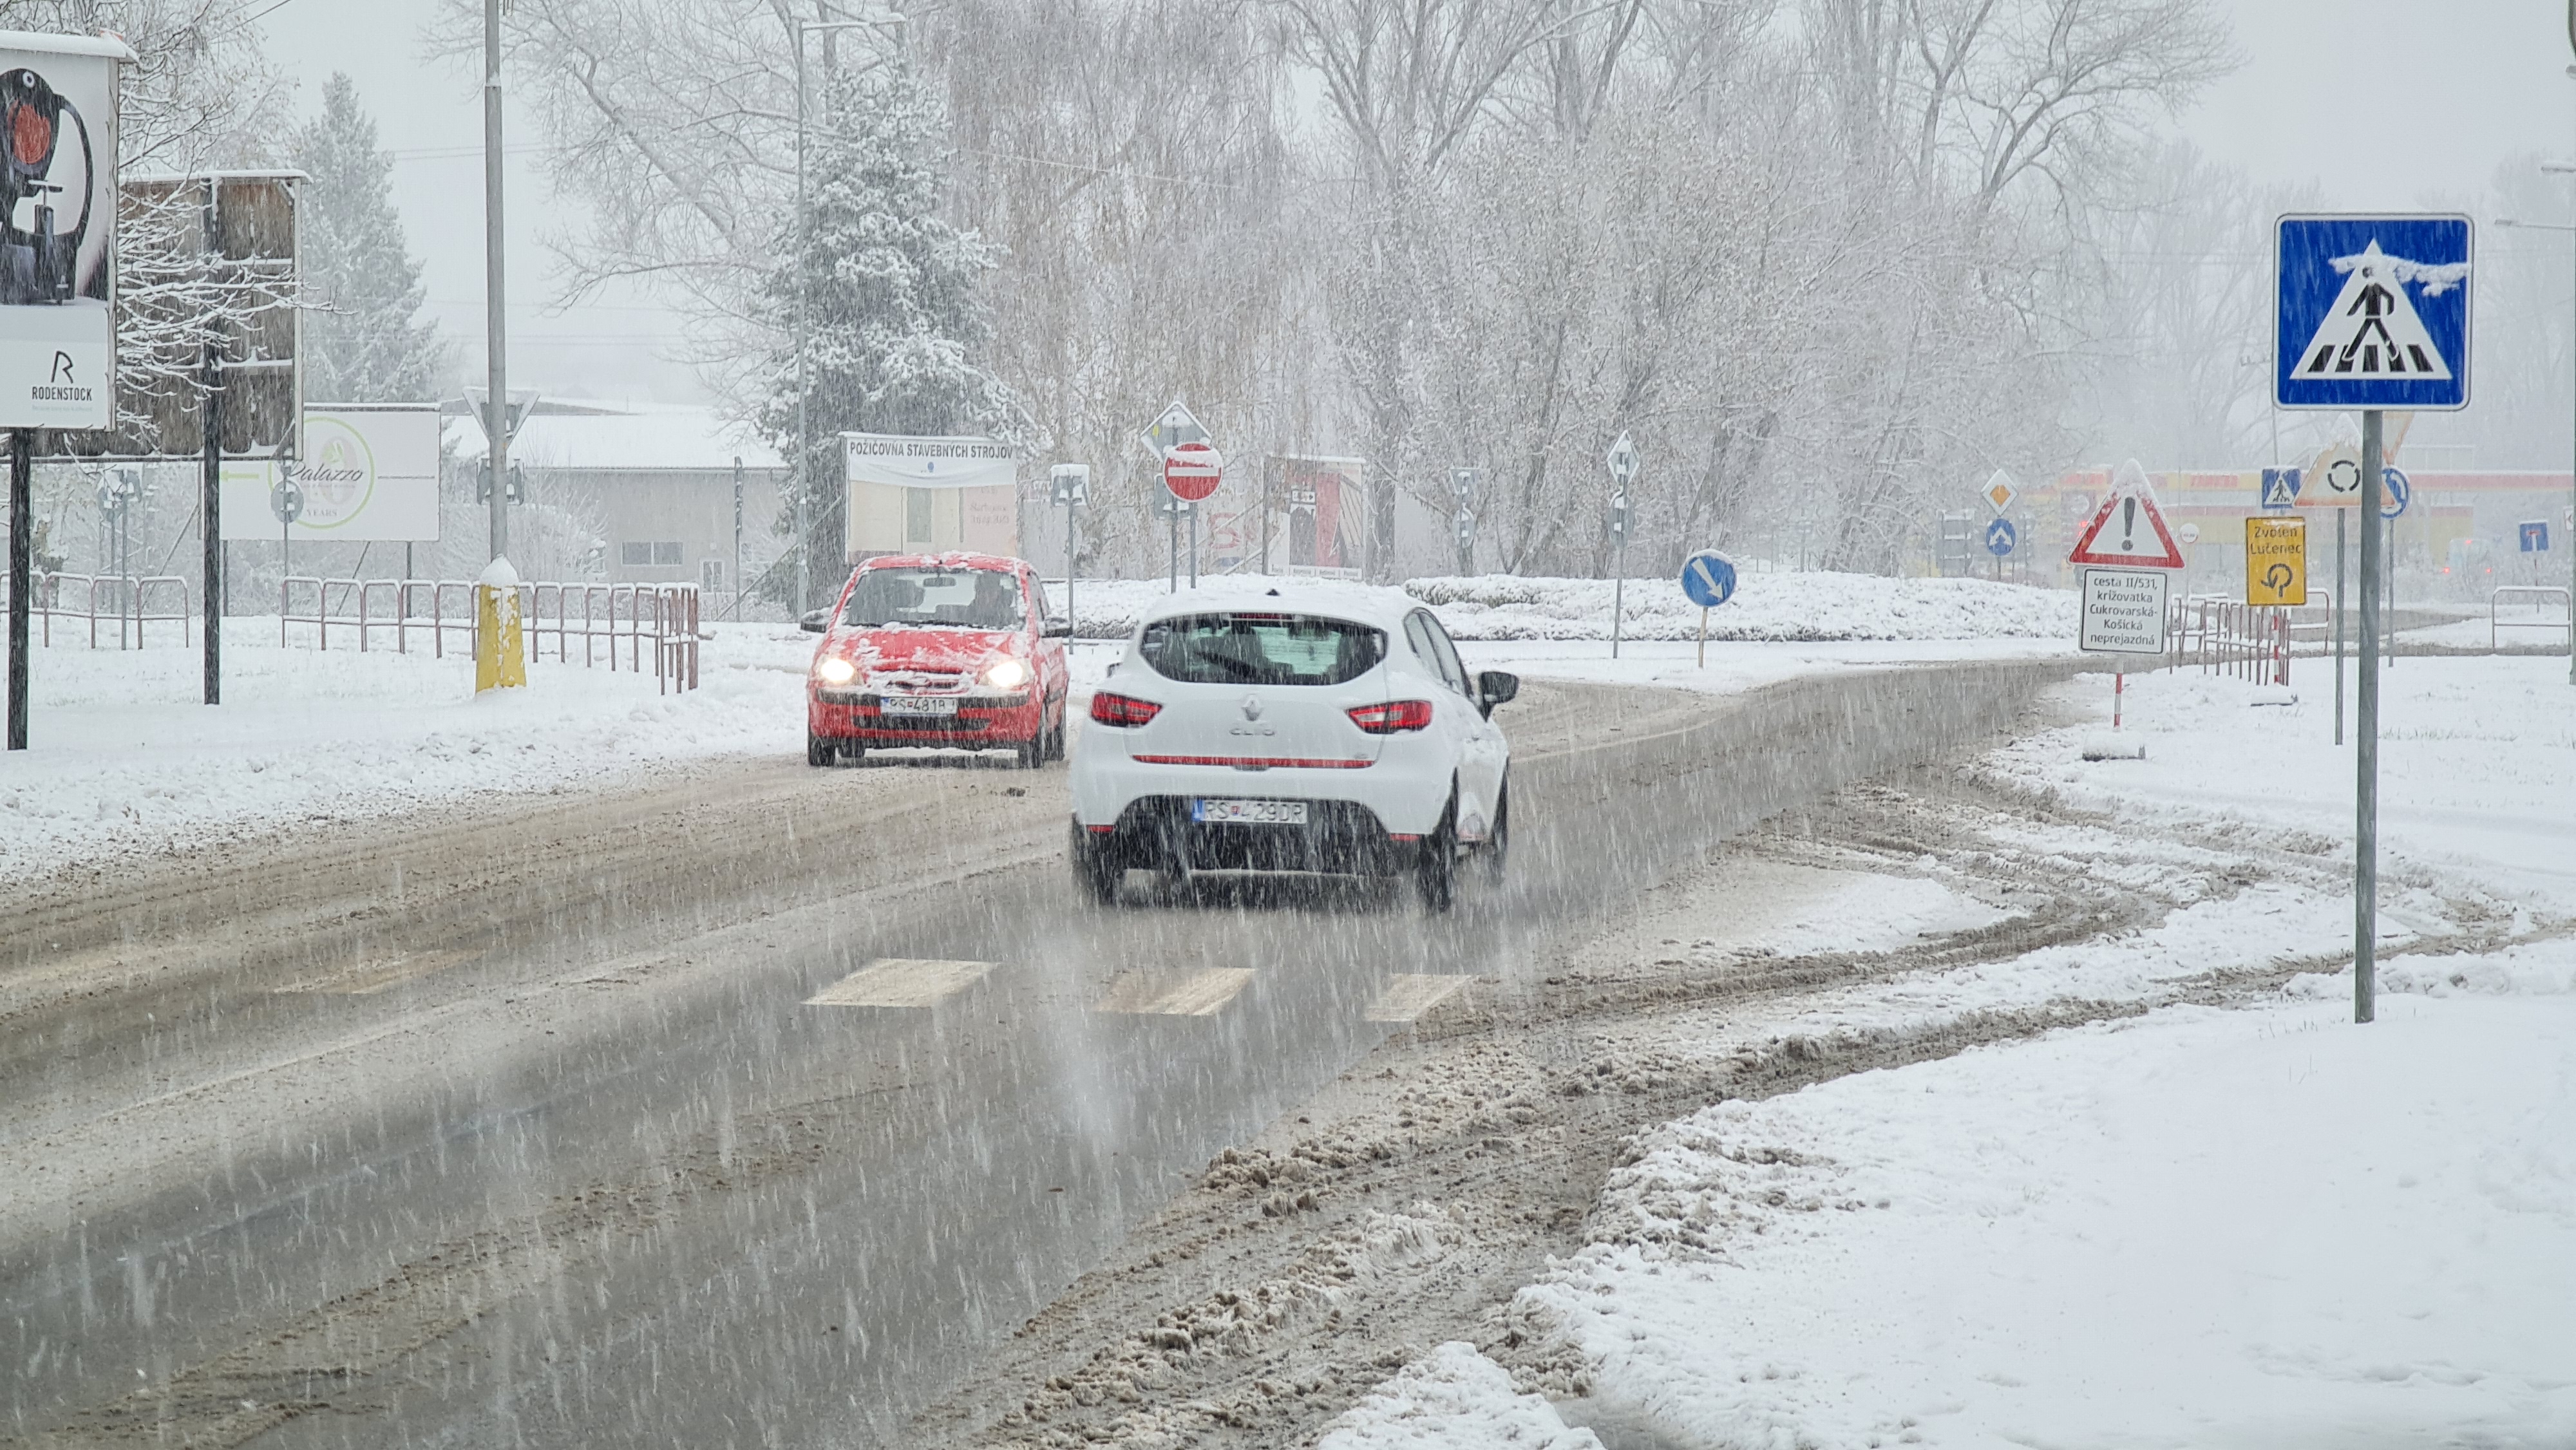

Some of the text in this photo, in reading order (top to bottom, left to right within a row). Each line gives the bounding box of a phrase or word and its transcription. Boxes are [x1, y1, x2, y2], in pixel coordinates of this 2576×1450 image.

[32, 386, 92, 401] RODENSTOCK
[971, 446, 1013, 459] STROJOV
[290, 461, 363, 482] Palazzo
[2254, 526, 2297, 538] Zvolen
[2094, 578, 2121, 587] cesta
[2090, 634, 2155, 646] neprejazdná
